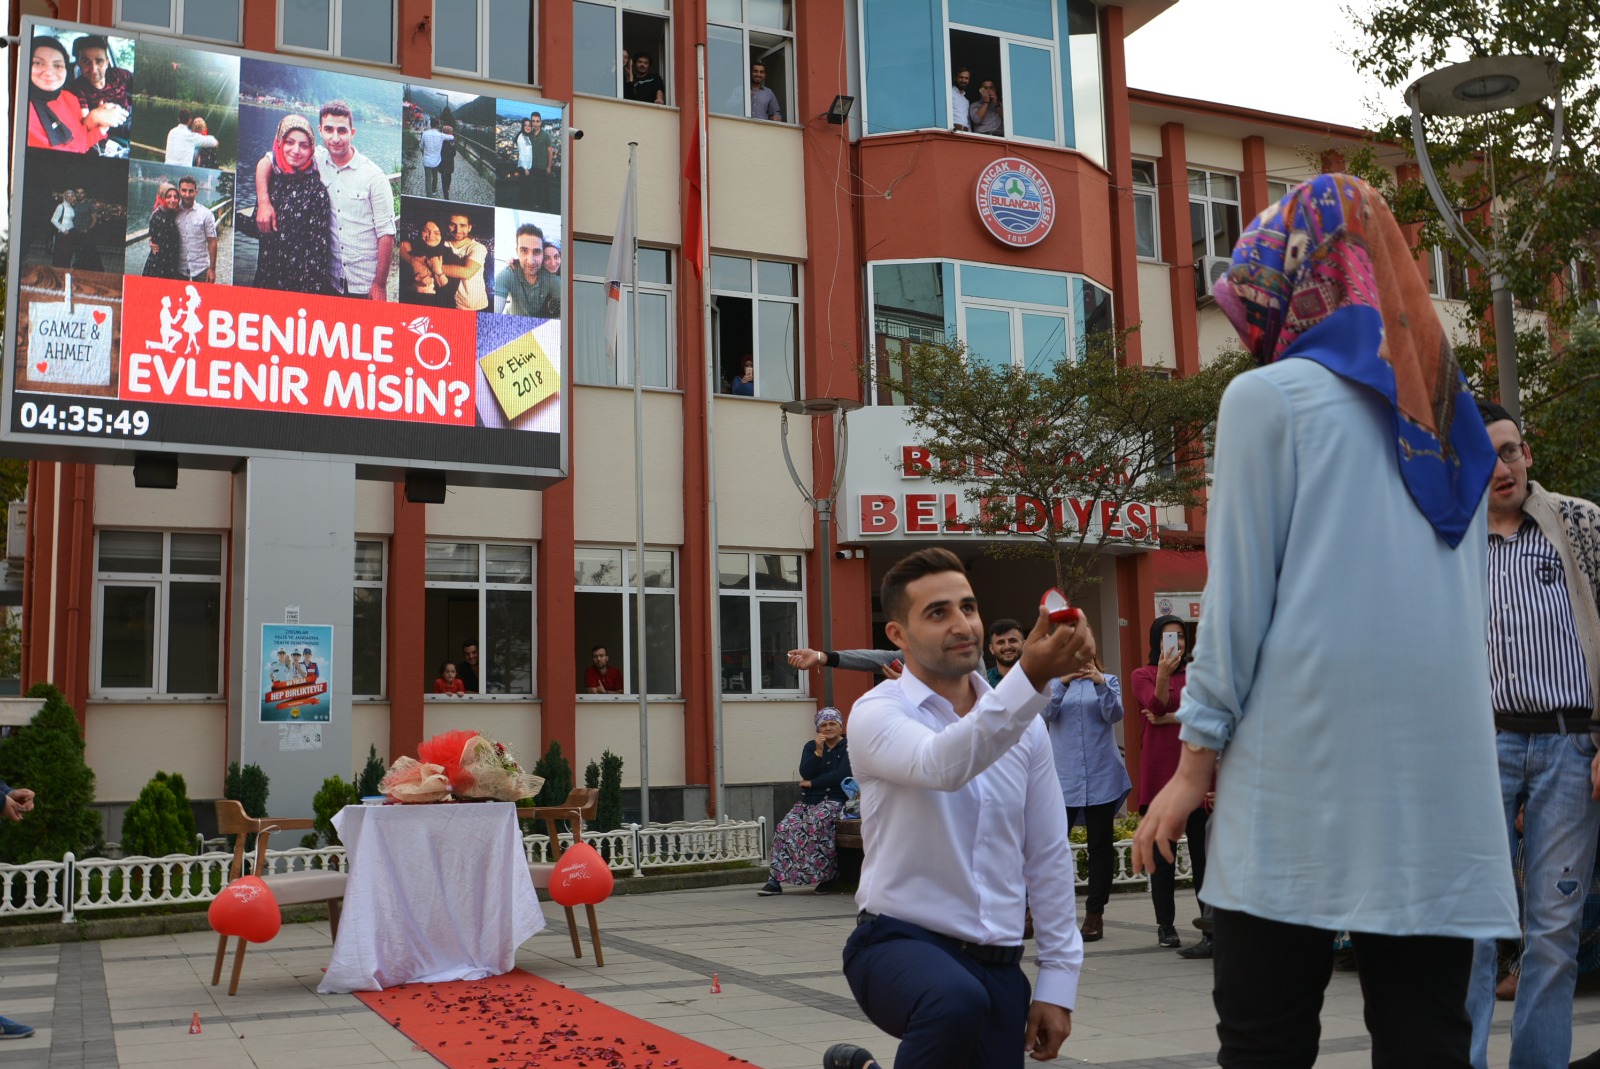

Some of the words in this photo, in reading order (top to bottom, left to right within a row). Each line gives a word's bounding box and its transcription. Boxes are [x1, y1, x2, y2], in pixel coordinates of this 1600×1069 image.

[980, 162, 1010, 216] BULANCAK
[991, 195, 1041, 211] BULANCAK
[39, 319, 87, 340] GAMZE
[90, 323, 100, 340] &
[207, 308, 394, 363] BENİMLE
[44, 342, 93, 362] AHMET
[497, 366, 505, 379] 8
[506, 352, 537, 373] Ekim
[128, 353, 309, 406] EVLENİR
[323, 363, 471, 418] MİSİN?
[512, 370, 543, 397] 2018
[20, 401, 150, 435] 04:35:49
[271, 690, 285, 701] HEP
